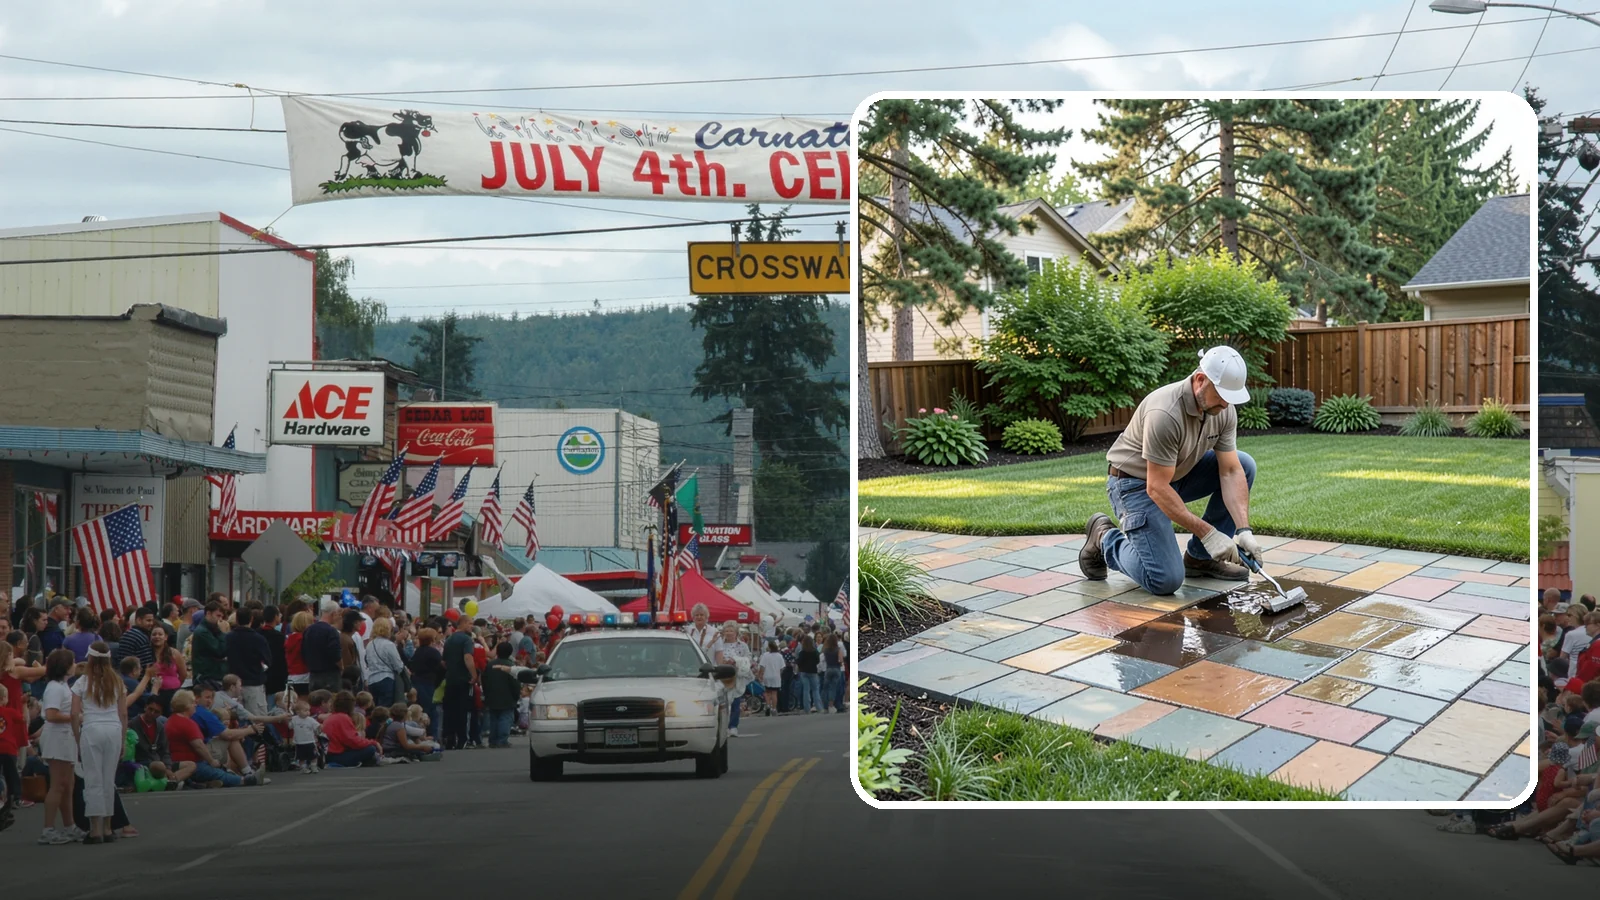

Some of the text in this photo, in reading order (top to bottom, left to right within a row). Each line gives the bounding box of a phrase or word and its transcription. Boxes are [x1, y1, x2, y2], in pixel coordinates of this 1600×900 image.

[695, 122, 850, 150] Carnat
[481, 141, 604, 192] JULY
[632, 150, 746, 197] 4th.
[697, 254, 850, 280] CROSSWA
[283, 380, 373, 420] ACE
[405, 409, 485, 422] CEDAR LOG
[283, 421, 370, 436] Hardware
[416, 428, 477, 446] Coca-Cola
[95, 485, 124, 494] Vincent
[126, 485, 136, 494] de
[137, 485, 155, 495] Paul
[687, 526, 741, 535] CRNATION
[699, 535, 730, 543] GLASS
